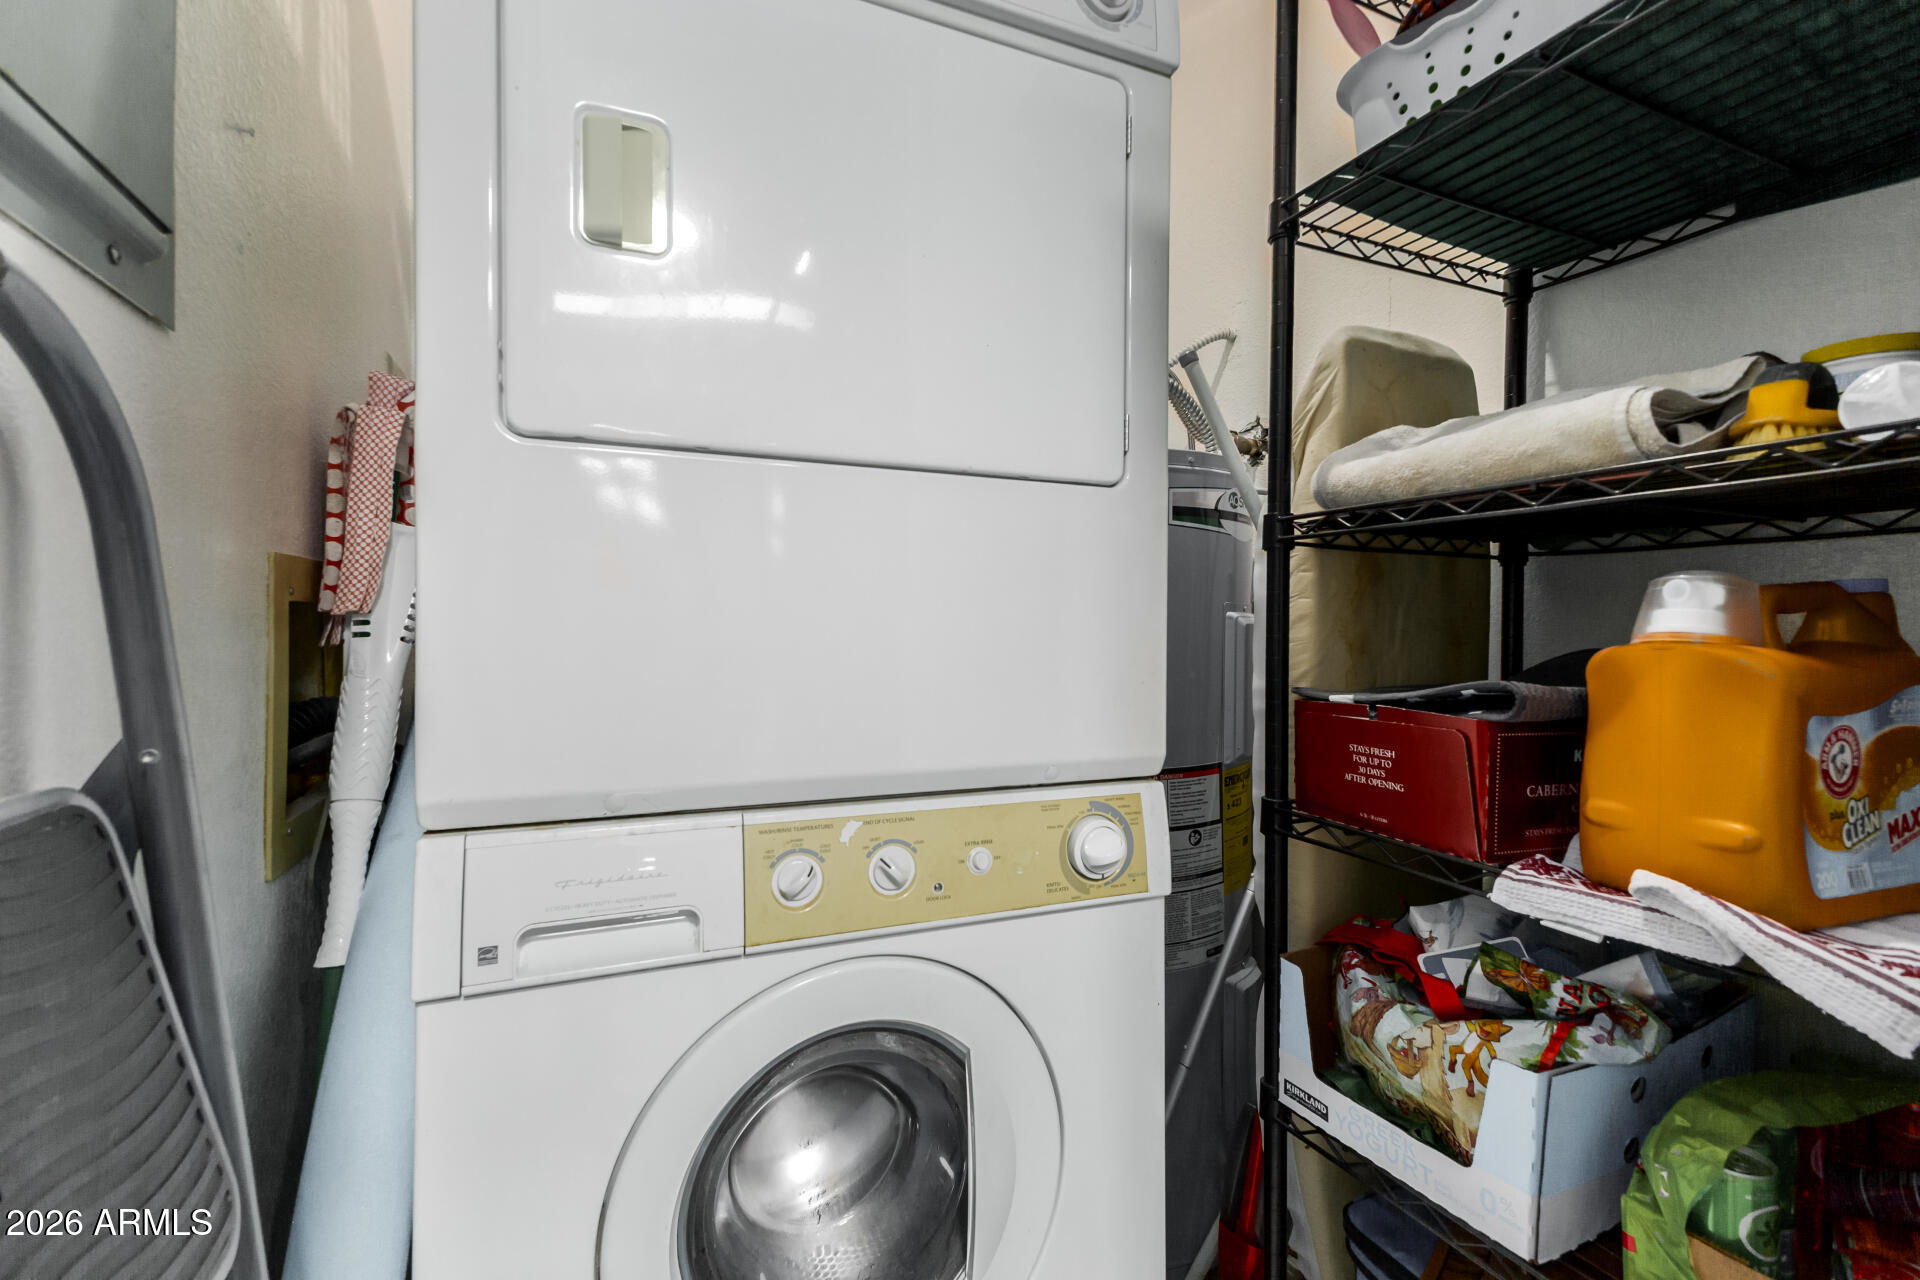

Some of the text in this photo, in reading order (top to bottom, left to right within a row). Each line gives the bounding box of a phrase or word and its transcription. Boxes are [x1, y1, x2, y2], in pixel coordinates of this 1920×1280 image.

[1349, 744, 1396, 759] STAYS FRESH
[1353, 754, 1392, 768] FOR UP TO
[1358, 765, 1386, 777] 30 DAYS
[1344, 773, 1404, 792] AFTER OPENING
[1848, 797, 1869, 823] OXI
[1842, 810, 1881, 849] CLEAN
[554, 872, 669, 890] Frigidaire
[1286, 1081, 1327, 1114] KIRKLAND
[1349, 1105, 1417, 1157] GREEK
[1335, 1110, 1433, 1185] YOGURT
